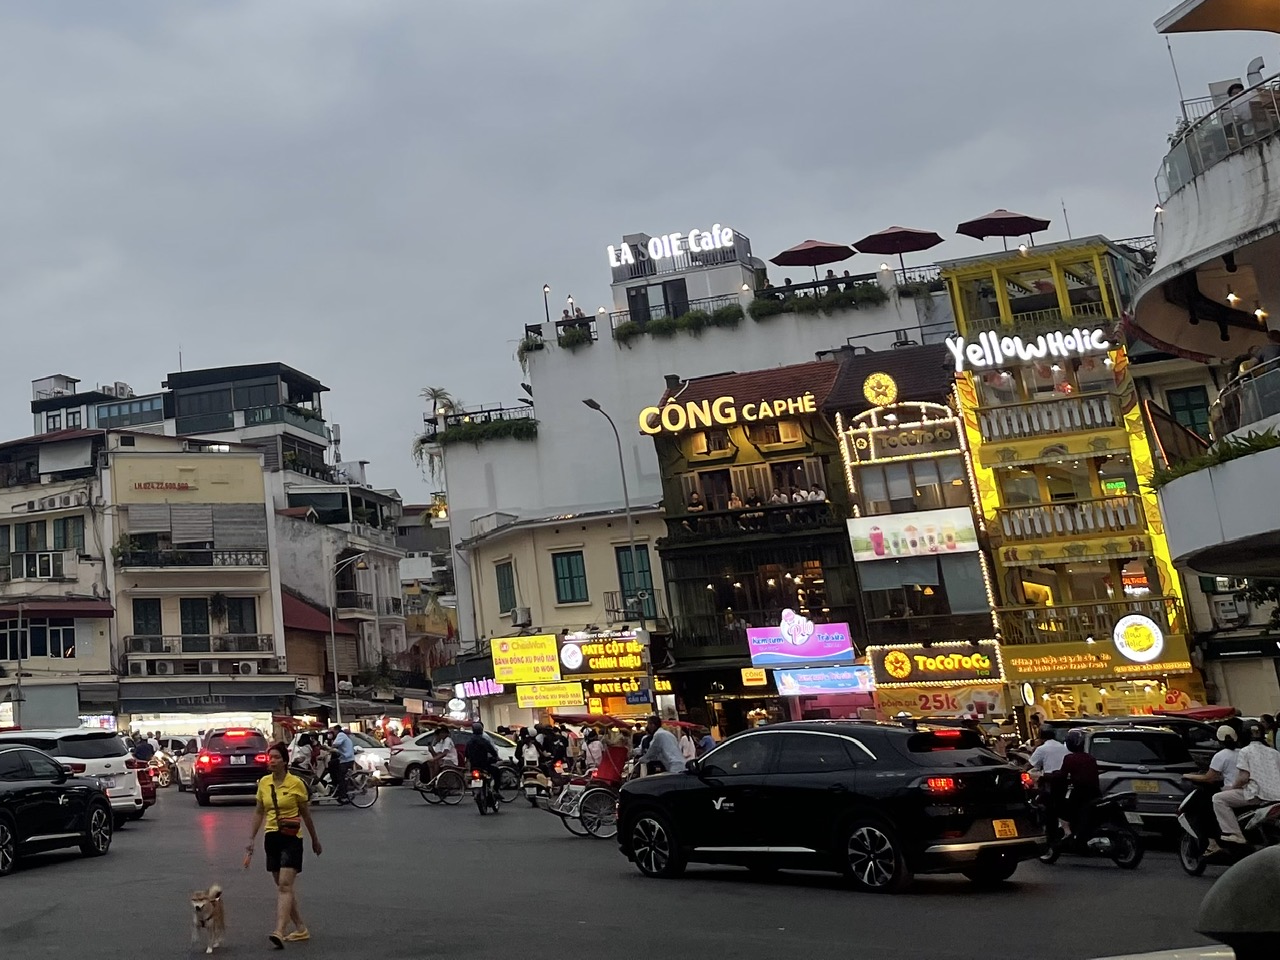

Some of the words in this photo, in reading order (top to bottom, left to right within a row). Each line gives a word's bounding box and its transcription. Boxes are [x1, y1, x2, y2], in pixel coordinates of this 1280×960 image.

[607, 242, 634, 267] LA
[637, 233, 684, 261] SOIE
[688, 223, 734, 252] Cafe
[582, 644, 605, 655] PATE
[589, 655, 617, 669] CHÍNH
[619, 653, 641, 669] HIỆU
[594, 682, 622, 693] PATE
[918, 693, 958, 711] 25k
